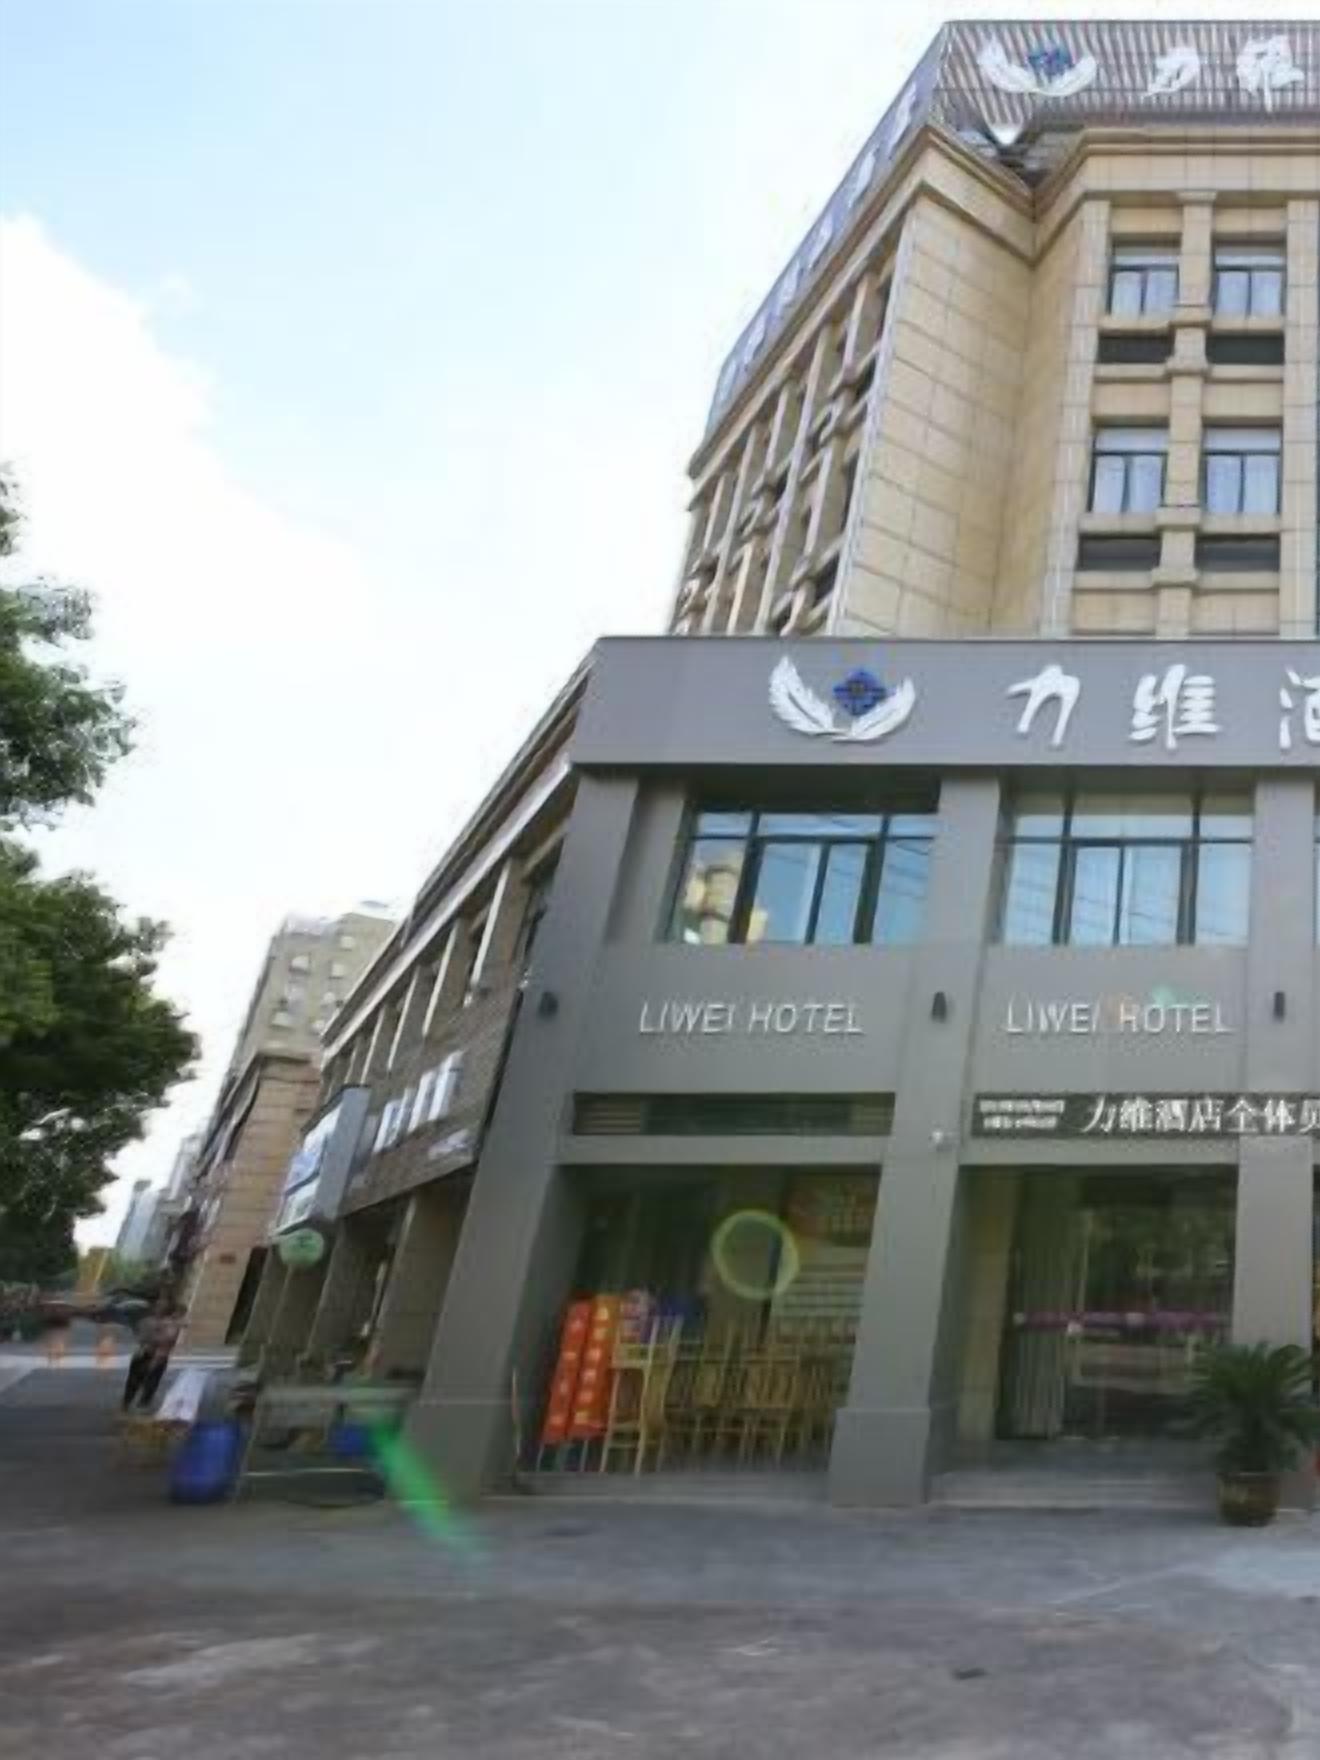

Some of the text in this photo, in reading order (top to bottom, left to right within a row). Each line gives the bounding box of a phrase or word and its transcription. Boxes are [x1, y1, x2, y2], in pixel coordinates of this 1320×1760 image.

[640, 1003, 864, 1034] LIWEI HOTEL
[1007, 1003, 1236, 1033] LIWEI HOTEL
